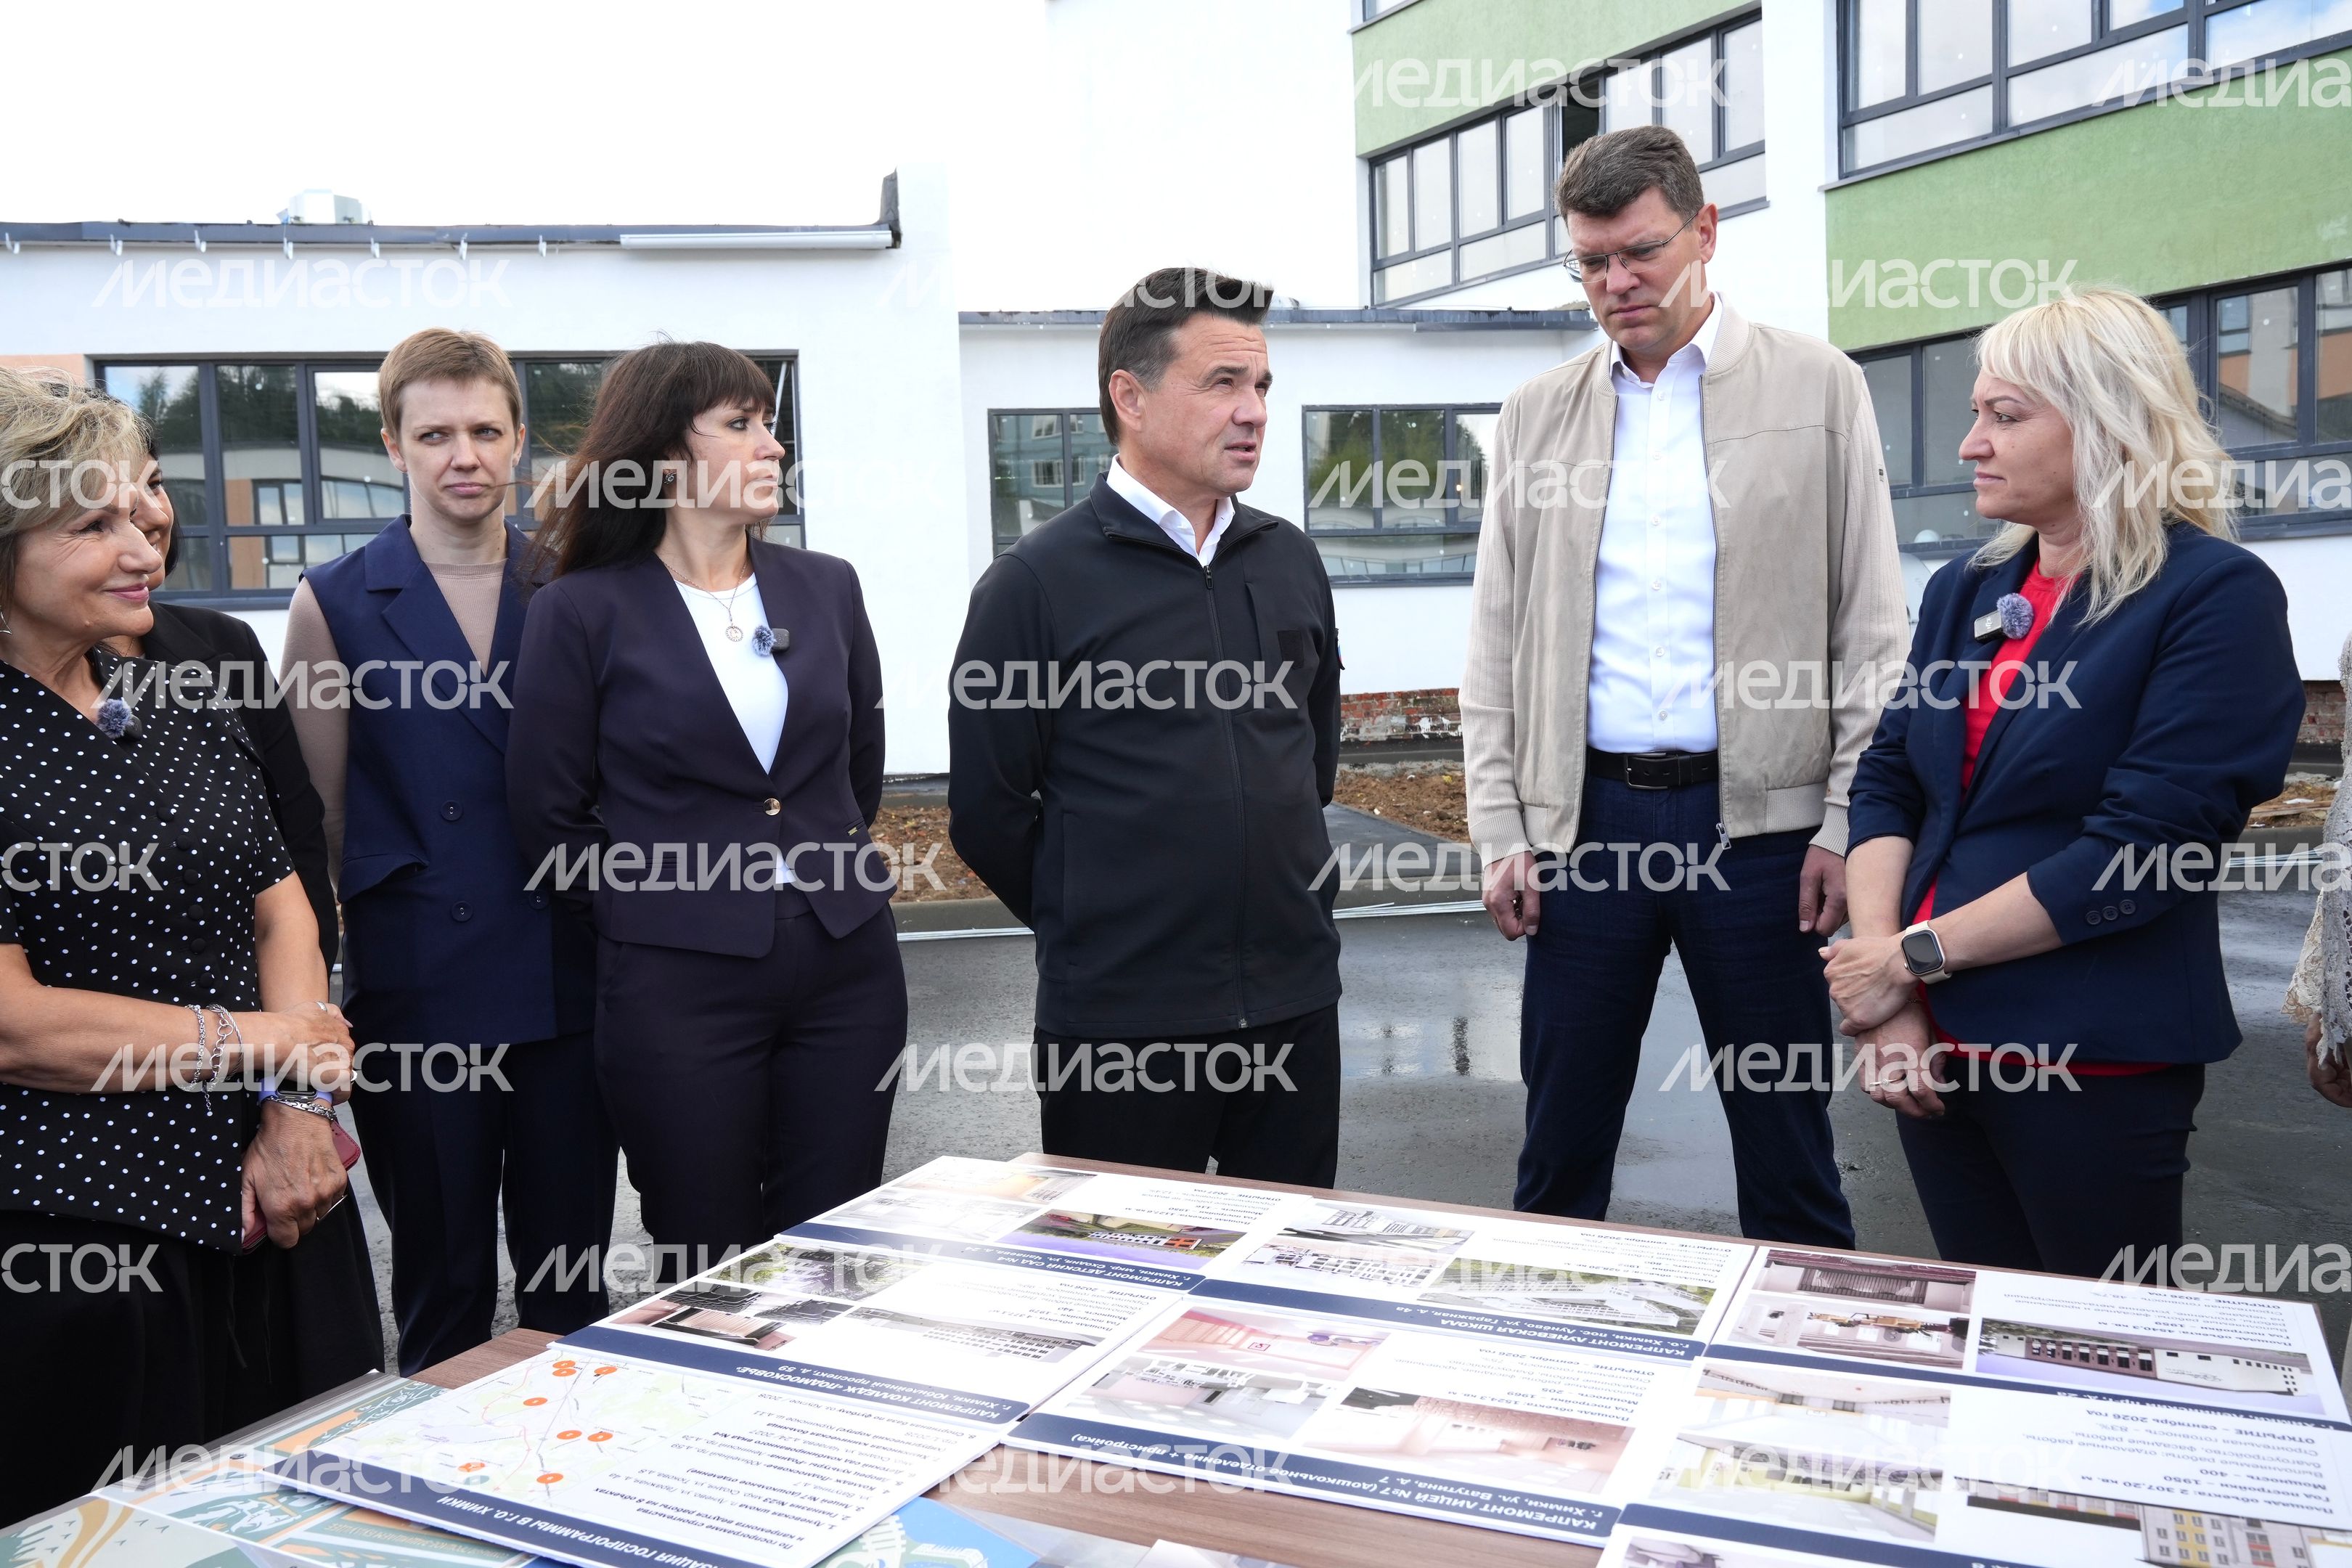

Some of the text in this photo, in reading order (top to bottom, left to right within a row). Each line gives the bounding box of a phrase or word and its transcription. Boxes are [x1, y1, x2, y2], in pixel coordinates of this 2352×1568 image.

[1045, 1263, 1106, 1275] ДЕТСКИЙ
[1104, 1272, 1184, 1287] КАПРЕМОНТ
[1441, 1319, 1686, 1357] КАПРЕМОНТ ЛУНЕВСКАЯ ШКОЛА
[1530, 1356, 1580, 1365] сентябрь
[812, 1370, 872, 1386] проспект,
[1594, 1365, 1655, 1376] ОТКРЫТИЕ
[844, 1386, 913, 1404] КОЛЛЕДЖ
[870, 1381, 951, 1401] Юбилейный
[1578, 1393, 1639, 1406] Мощность
[910, 1398, 1000, 1419] КАПРЕМОНТ
[950, 1394, 1000, 1410] Химки,
[1551, 1397, 1612, 1410] постройки
[2112, 1413, 2149, 1424] 2026
[2152, 1418, 2218, 1431] сентябрь
[1069, 1432, 1168, 1457] пристройка)
[2235, 1429, 2316, 1445] ОТКРЫТИЕ
[1182, 1450, 1267, 1473] отделение
[1267, 1466, 1379, 1493] (дошкольное
[2123, 1482, 2175, 1493] 307,20
[2200, 1469, 2327, 1491] Мощность 400
[1414, 1480, 1493, 1501] Ватутина,
[2163, 1476, 2331, 1503] Год постройки 1950
[2194, 1491, 2260, 1504] объекта:
[436, 1492, 495, 1516] ХИМКИ
[1414, 1493, 1479, 1510] ЛИЦЕЙ
[1498, 1495, 1522, 1504] ул.
[1524, 1498, 1587, 1517] Химки,
[2263, 1500, 2335, 1515] Площадь
[494, 1509, 521, 1524] Г.О.
[636, 1508, 706, 1527] строительства
[1479, 1503, 1598, 1530] КАПРЕМОНТ
[529, 1519, 658, 1559] ГОСПРОГРАММЫ
[705, 1524, 778, 1545] госпрограмме
